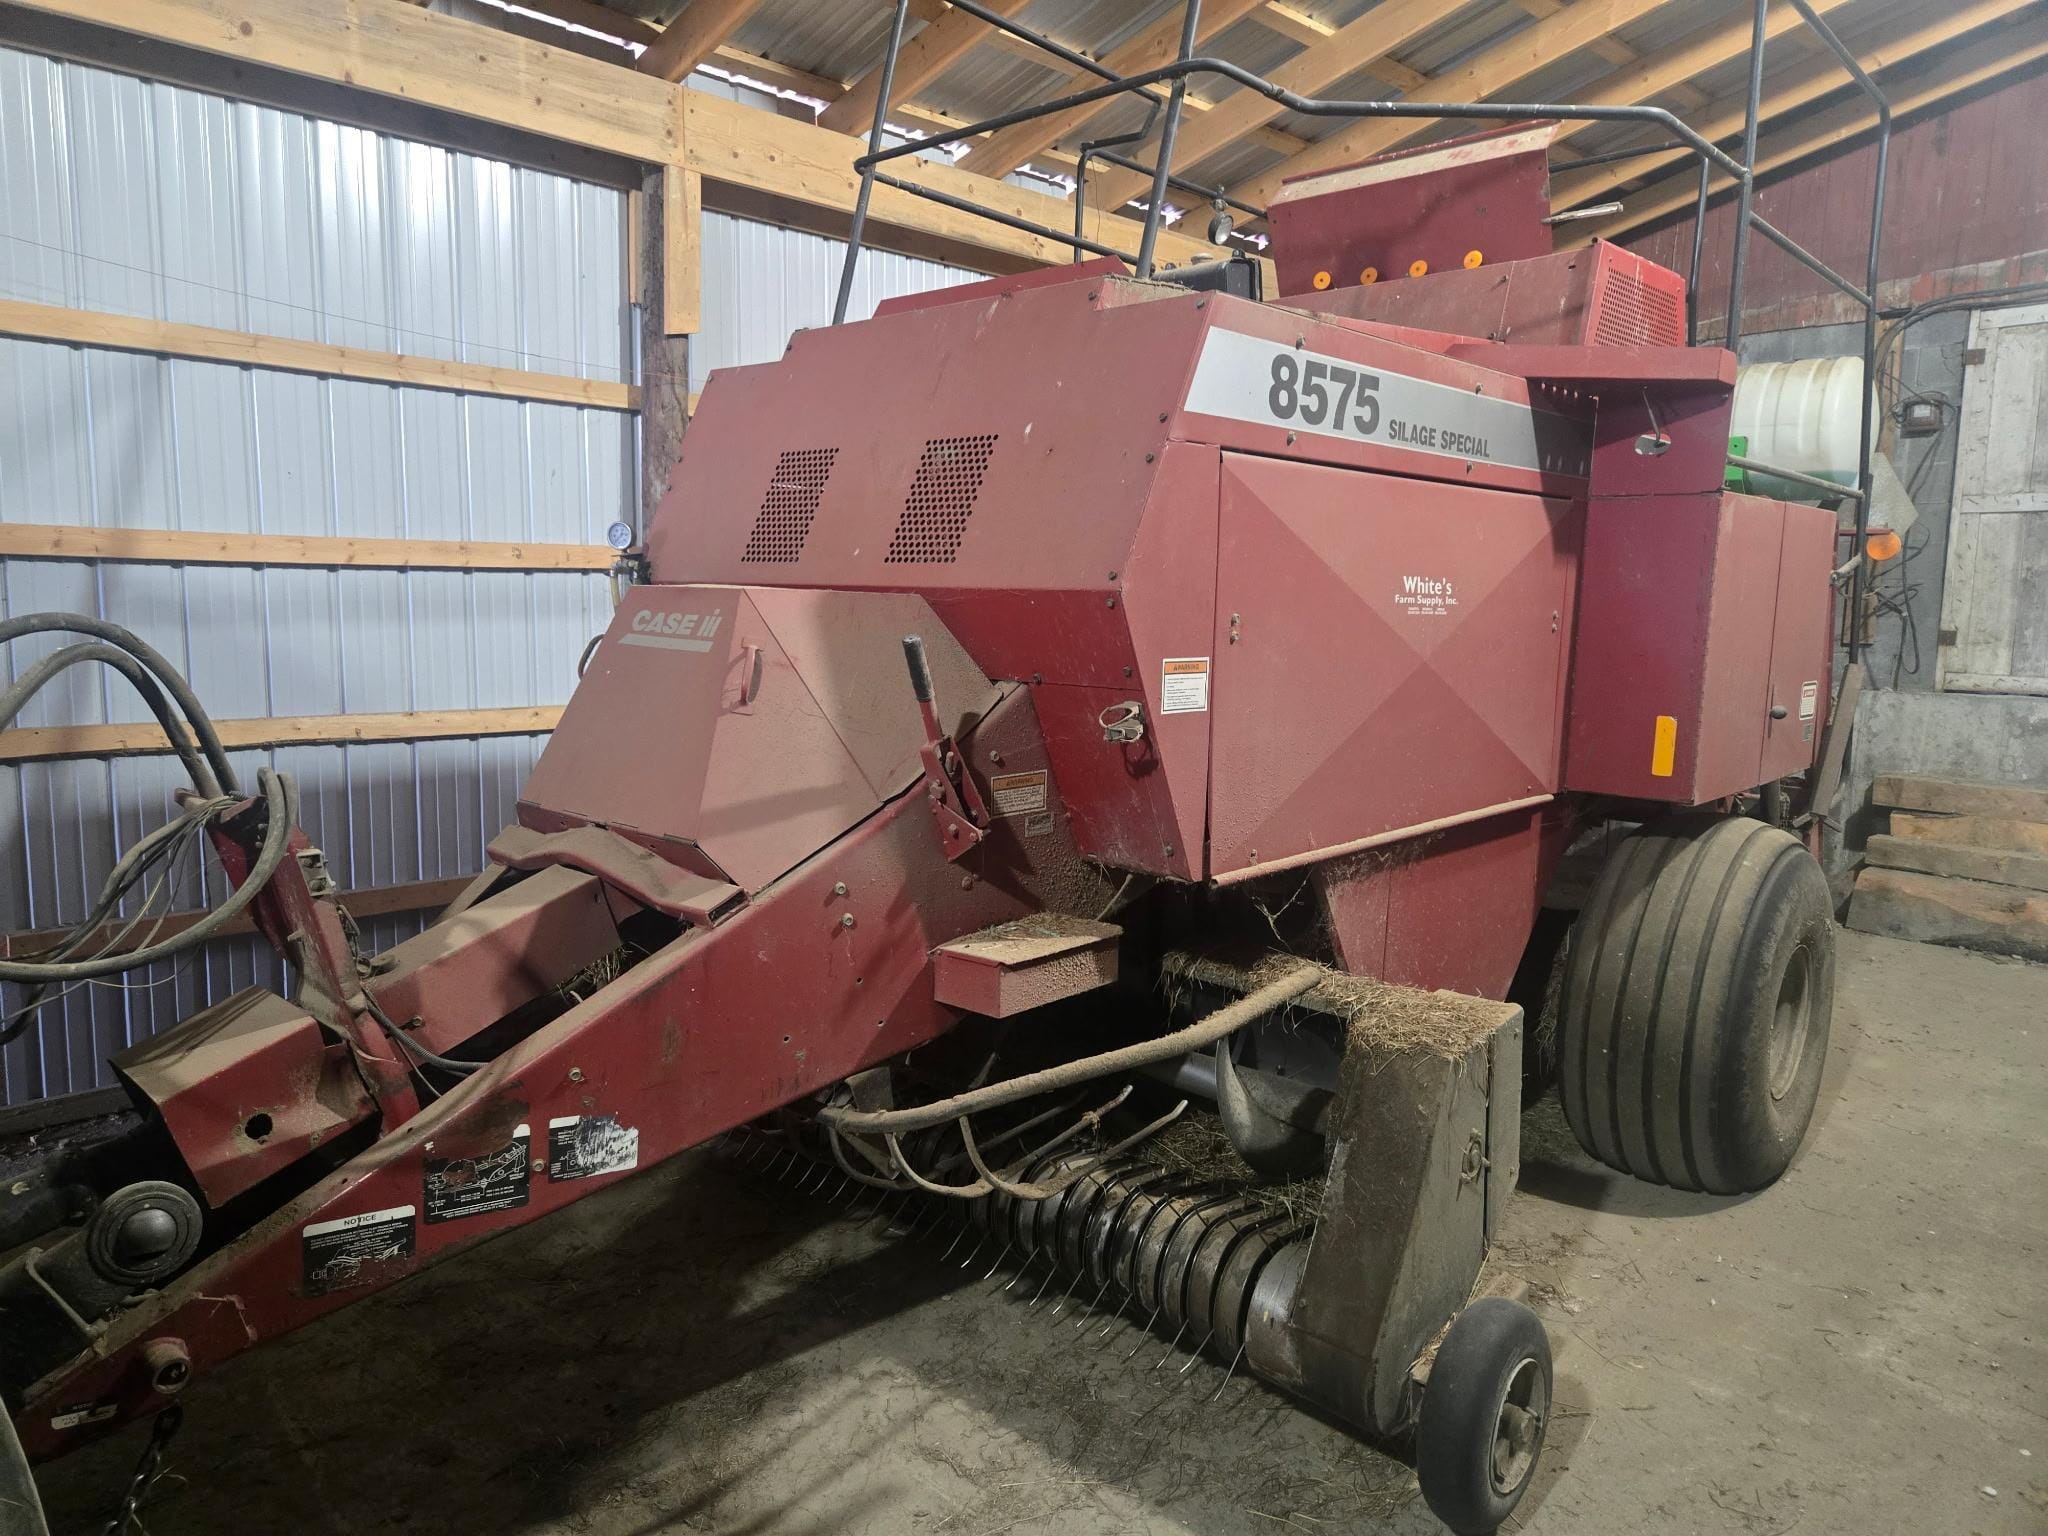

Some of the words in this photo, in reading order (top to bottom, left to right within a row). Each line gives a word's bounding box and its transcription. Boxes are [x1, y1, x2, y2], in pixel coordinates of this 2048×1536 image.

[1269, 354, 1380, 434] 8575
[1388, 419, 1437, 448] SILAGE
[1440, 432, 1490, 457] SPECIAL
[1403, 576, 1452, 594] White's
[1395, 594, 1415, 604] Farm
[1417, 595, 1444, 606] Supply,
[1445, 596, 1460, 605] Inc.
[631, 609, 699, 636] CASE
[344, 1213, 377, 1226] NOTICE
